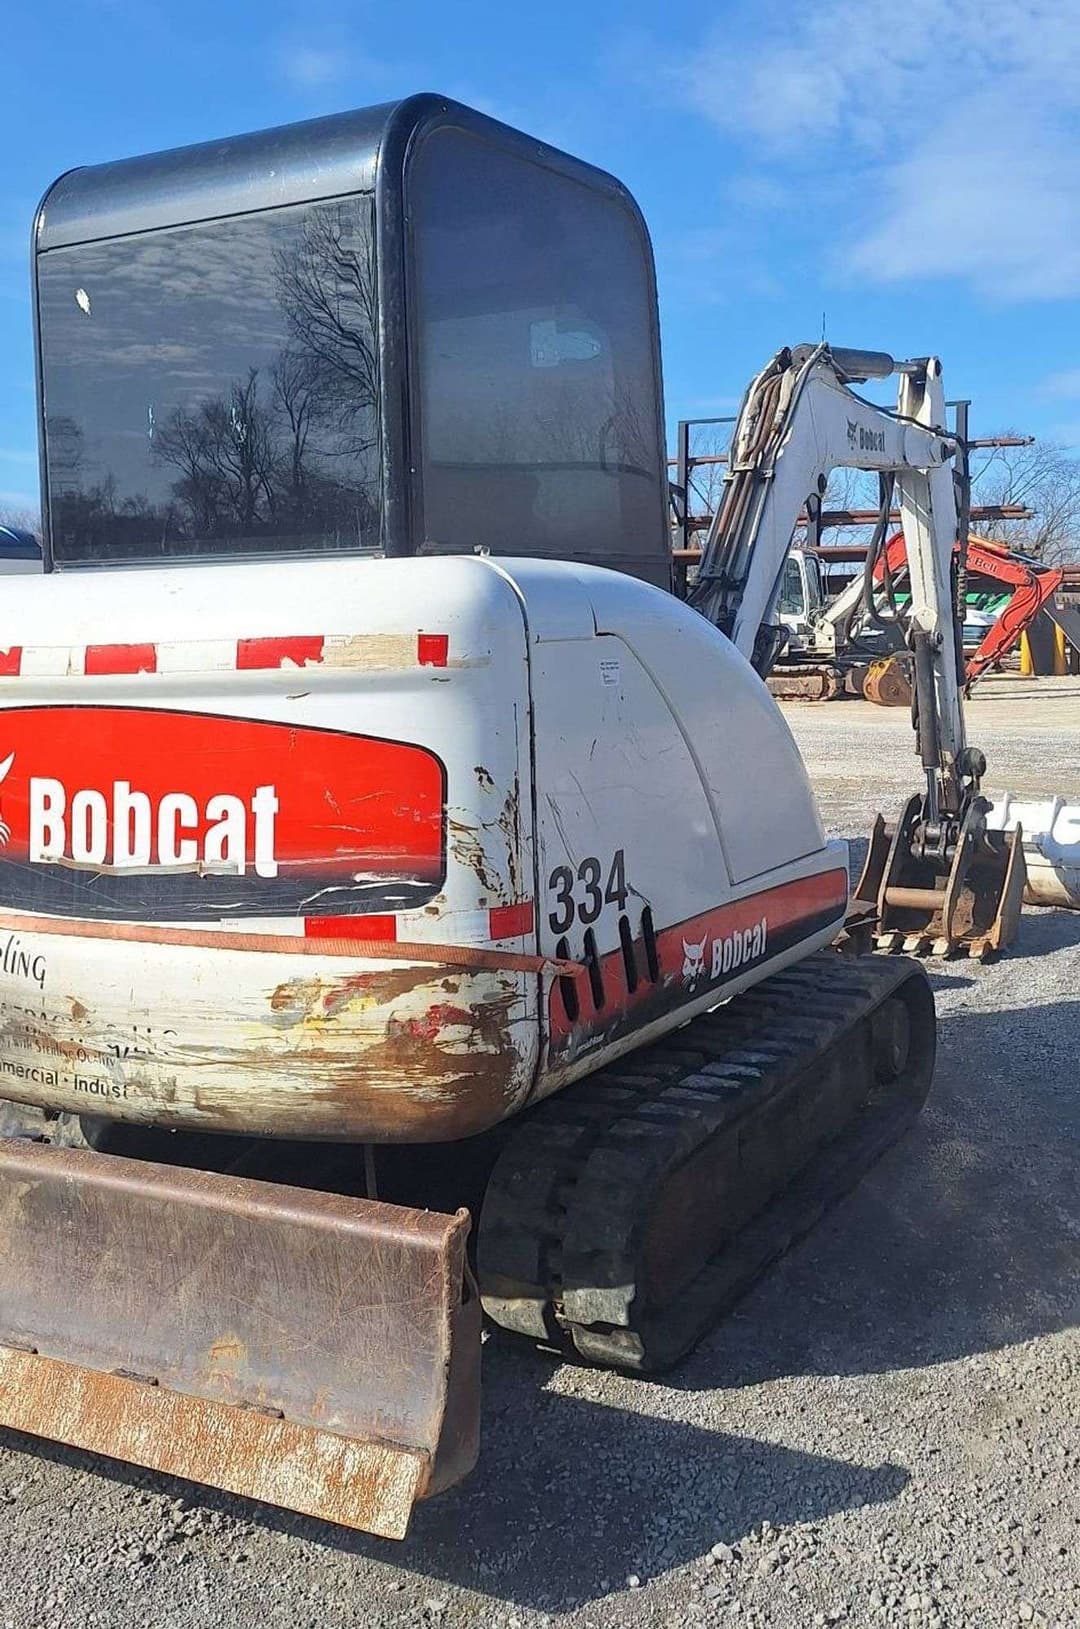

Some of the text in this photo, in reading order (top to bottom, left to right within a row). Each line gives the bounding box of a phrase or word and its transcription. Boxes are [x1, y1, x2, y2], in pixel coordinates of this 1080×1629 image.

[860, 427, 885, 452] Bobcat
[975, 557, 997, 572] Bell
[29, 777, 279, 878] Bobcat
[548, 849, 629, 935] 334
[710, 917, 768, 980] Bobcat
[0, 1060, 59, 1086] mercial
